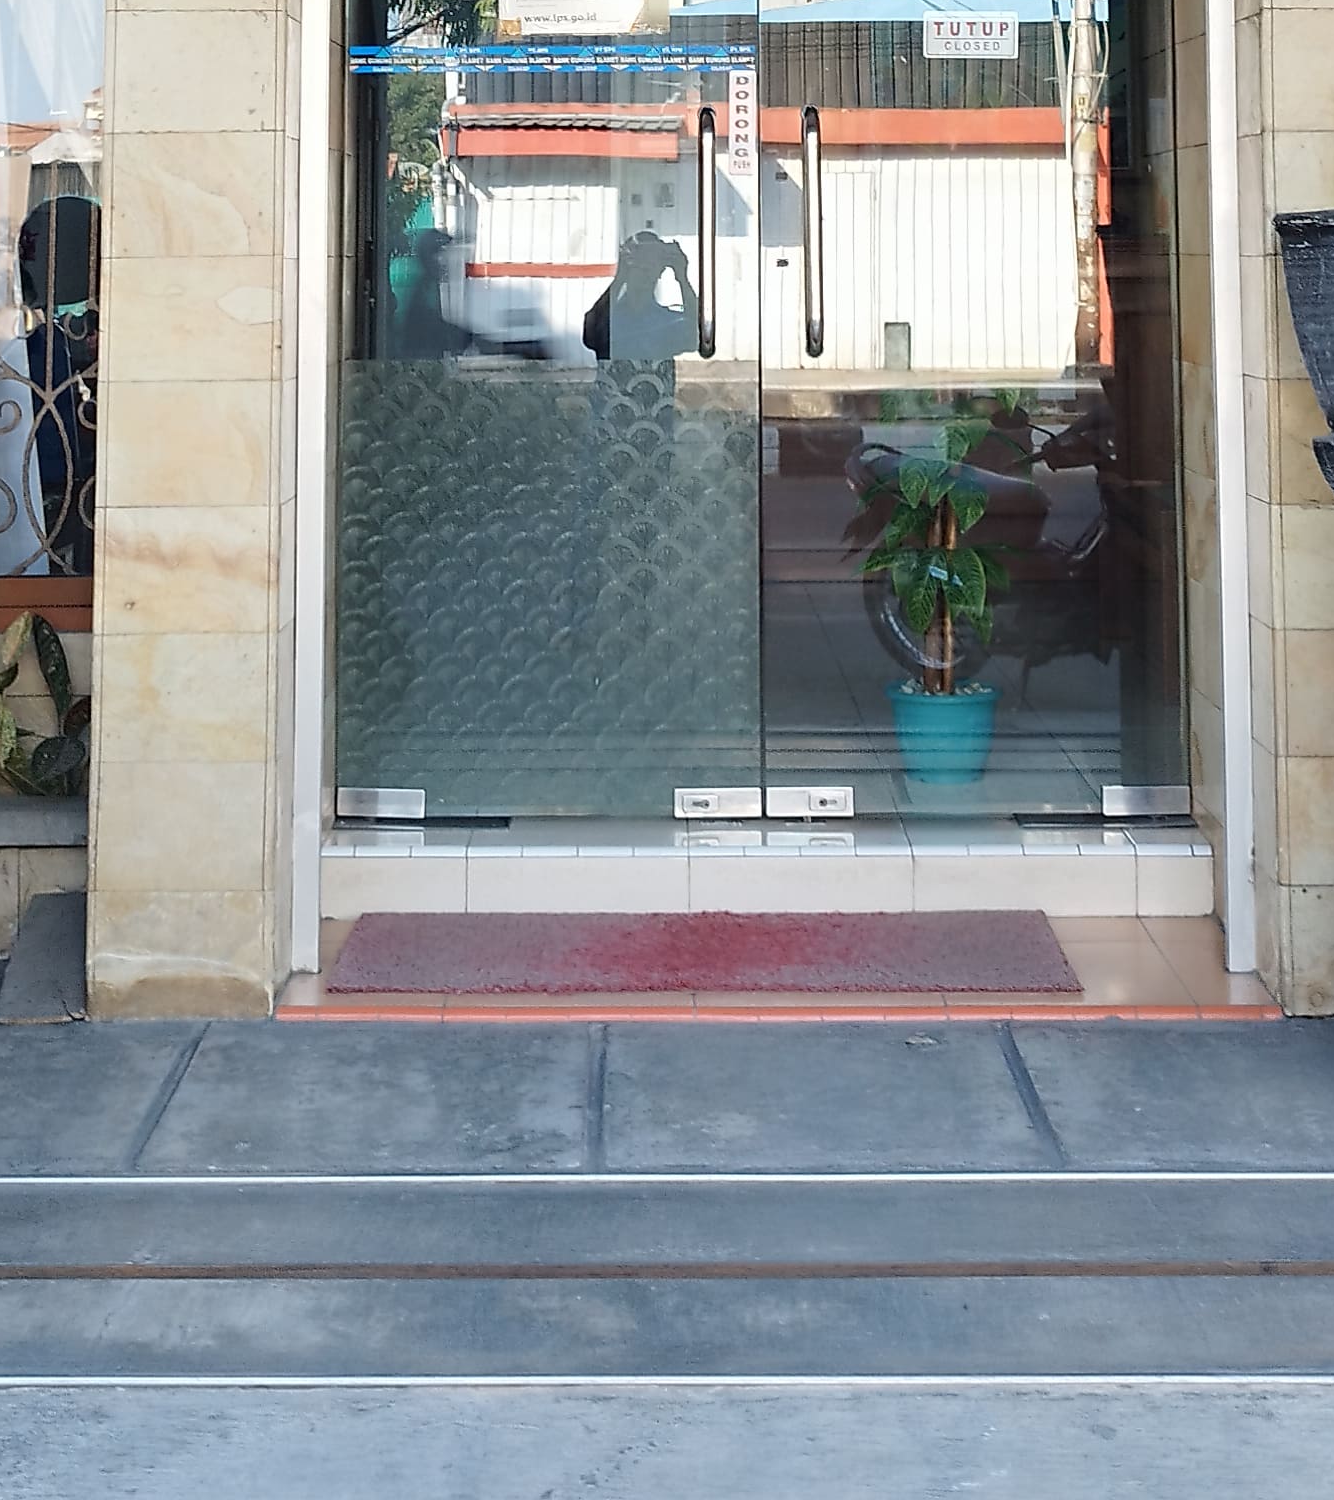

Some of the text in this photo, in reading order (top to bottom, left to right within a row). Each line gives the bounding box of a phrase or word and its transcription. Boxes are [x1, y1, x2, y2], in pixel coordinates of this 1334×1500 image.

[933, 21, 1009, 37] TUTUP
[944, 41, 1001, 51] CLOSED
[734, 76, 750, 158] DORONG
